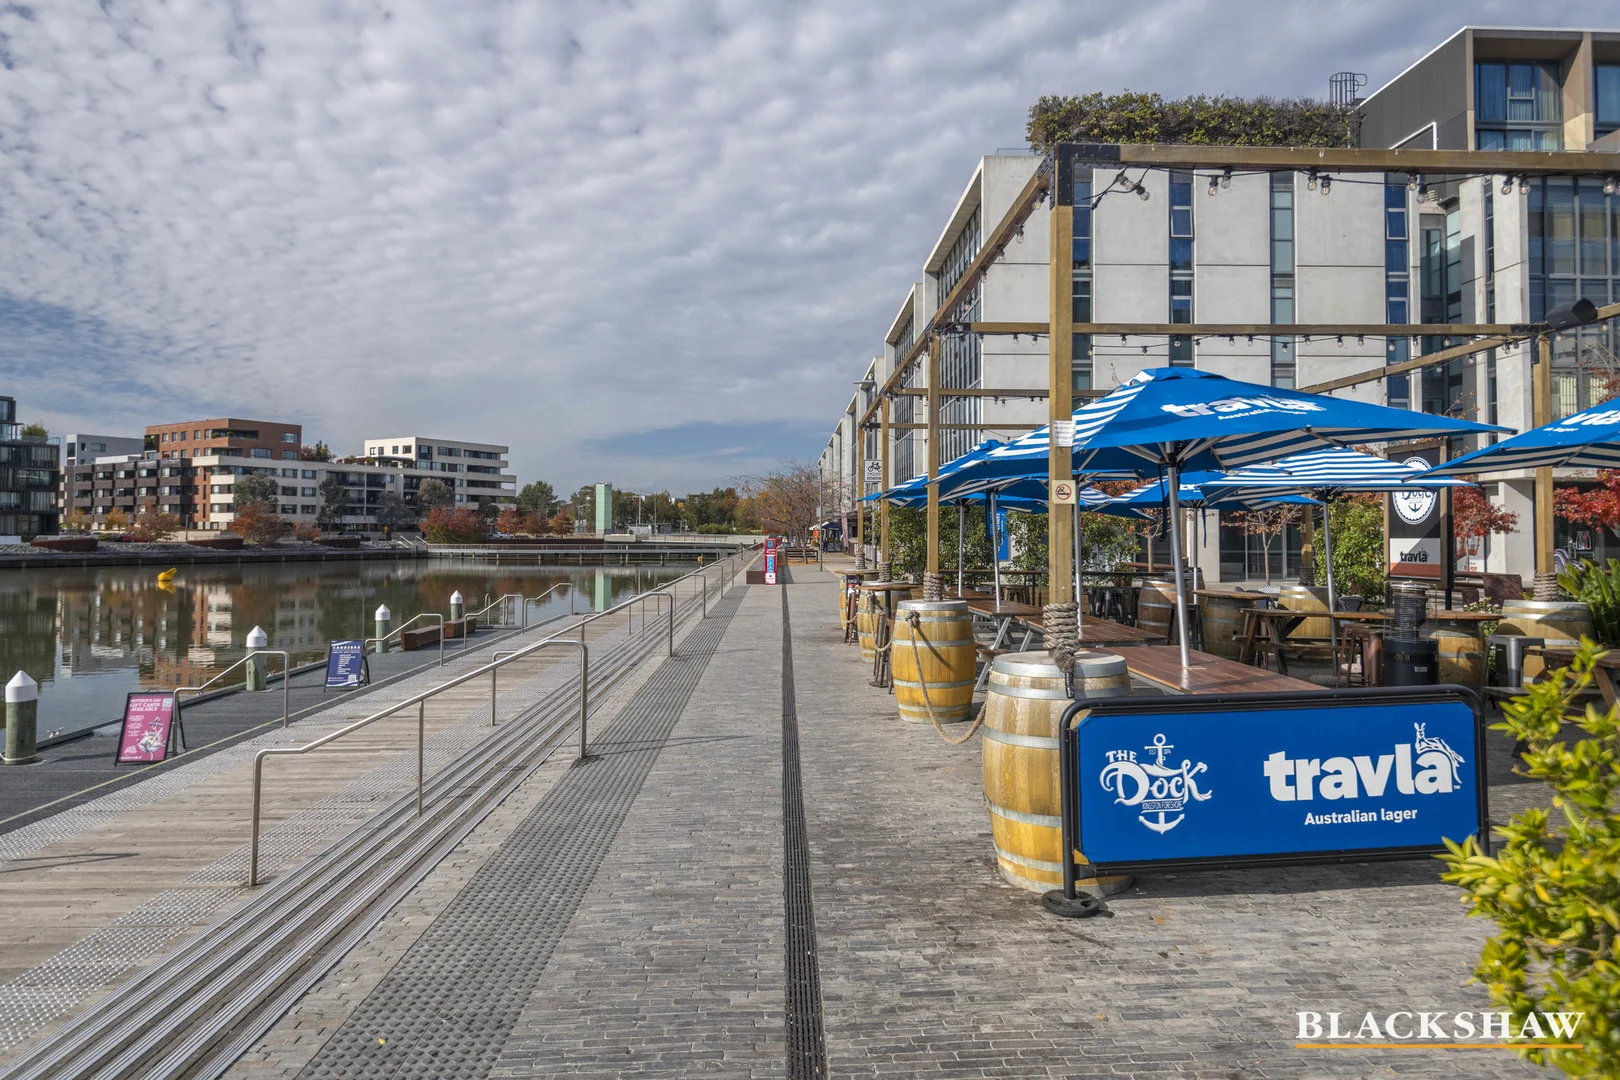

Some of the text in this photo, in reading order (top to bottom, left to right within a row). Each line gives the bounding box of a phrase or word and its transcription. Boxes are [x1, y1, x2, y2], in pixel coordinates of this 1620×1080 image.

[1160, 397, 1322, 417] travla
[1400, 550, 1428, 563] travla
[1105, 750, 1138, 764] THE
[1263, 743, 1454, 802] travla
[1141, 800, 1183, 810] KINGSTON FORESHORE
[1304, 808, 1418, 826] Australian lager
